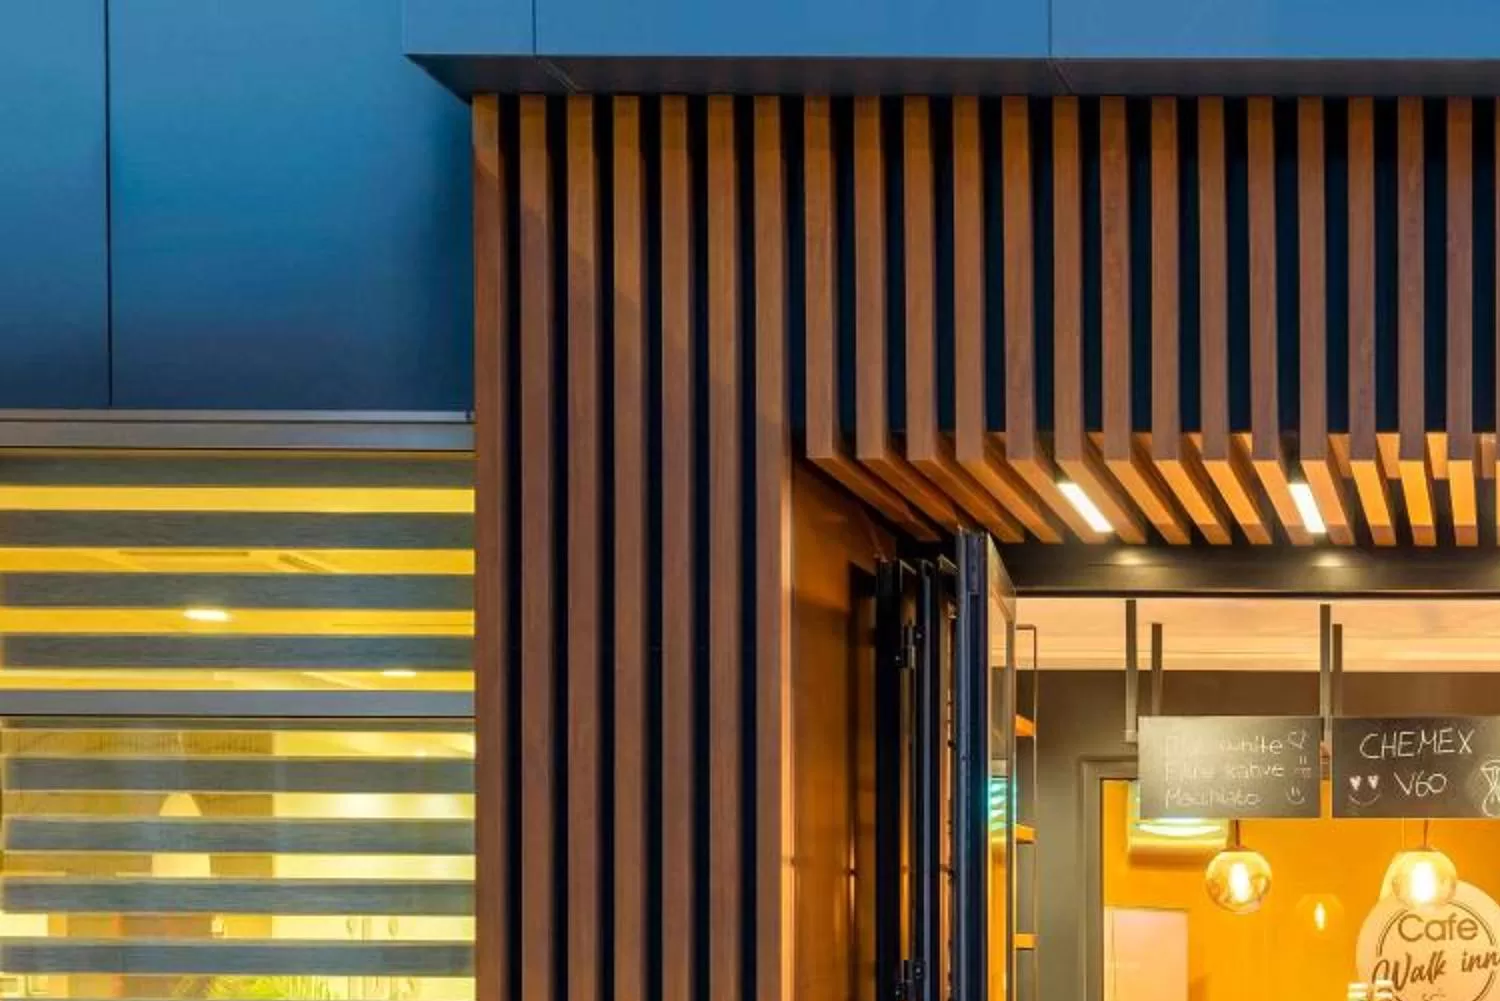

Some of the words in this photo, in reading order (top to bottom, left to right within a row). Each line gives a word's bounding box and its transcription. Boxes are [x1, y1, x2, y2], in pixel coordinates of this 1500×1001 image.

[1359, 727, 1476, 760] CHEMEX
[1393, 769, 1448, 797] V60
[1397, 912, 1479, 943] Cafe
[1371, 950, 1449, 992] Walk
